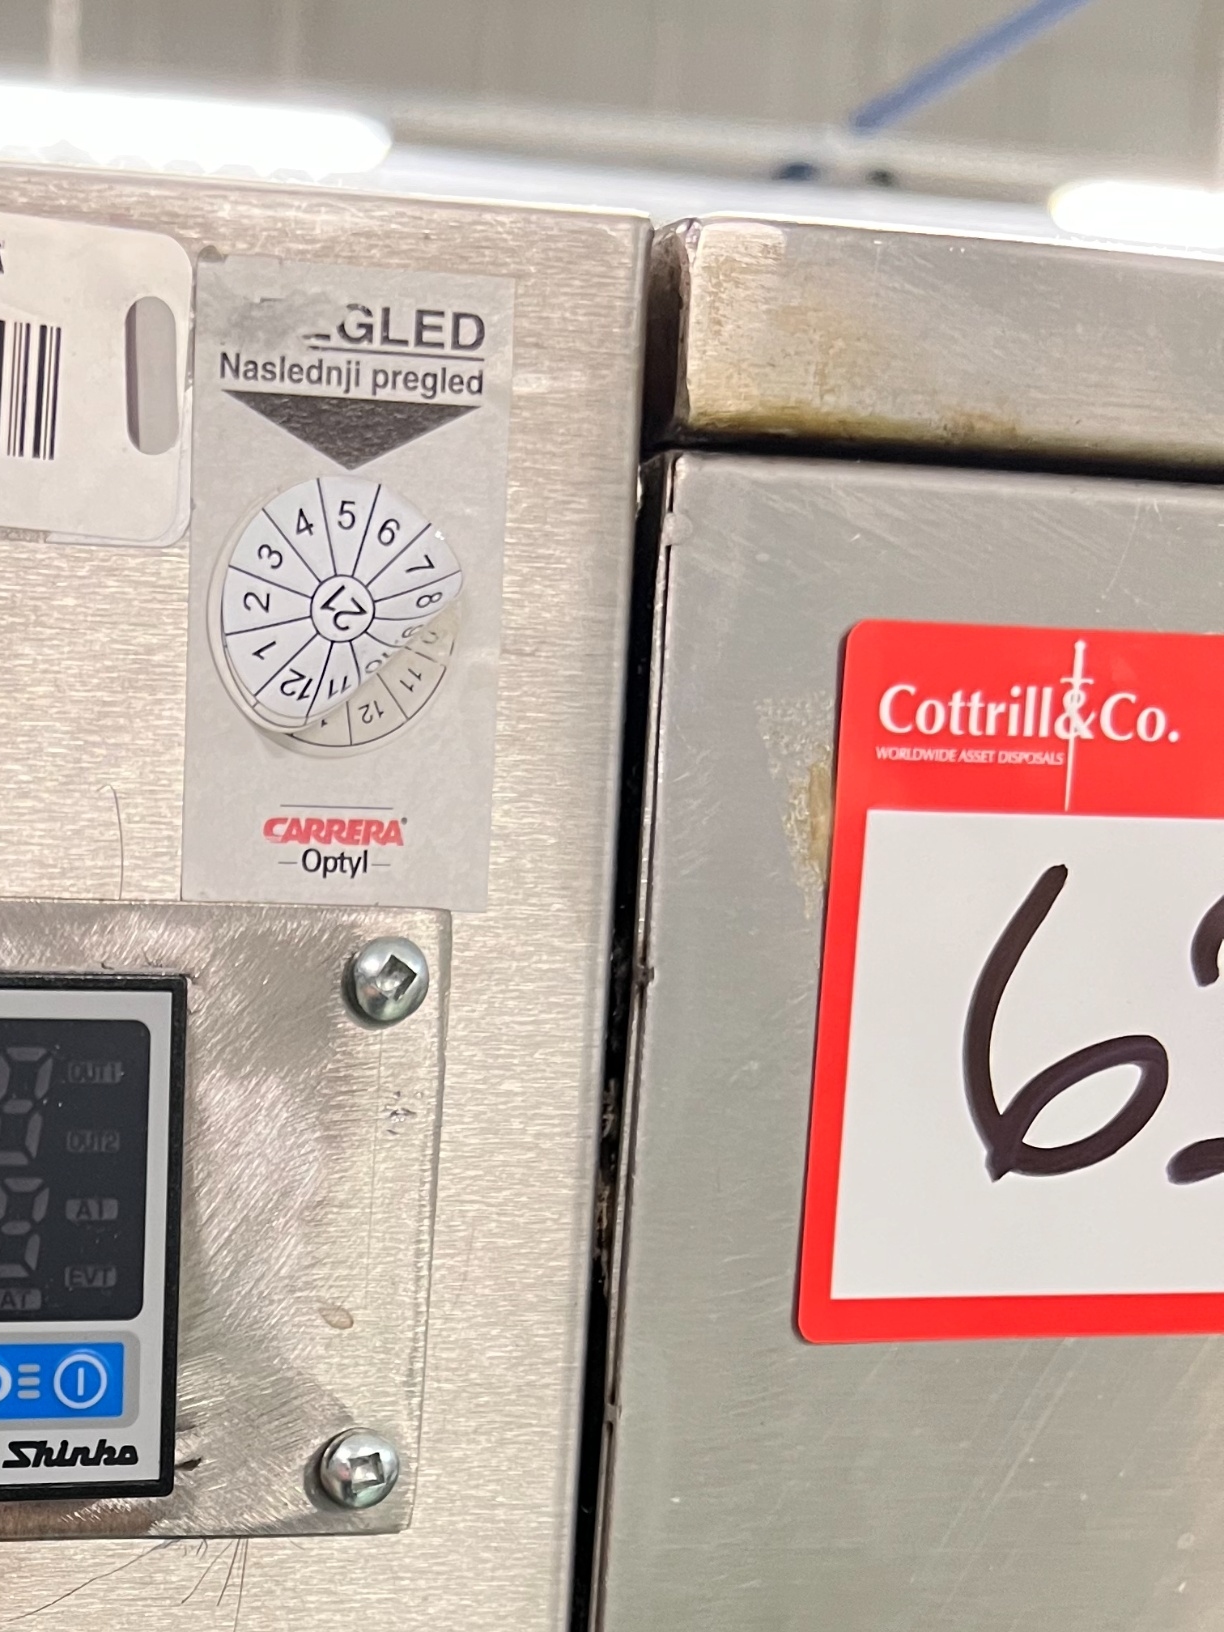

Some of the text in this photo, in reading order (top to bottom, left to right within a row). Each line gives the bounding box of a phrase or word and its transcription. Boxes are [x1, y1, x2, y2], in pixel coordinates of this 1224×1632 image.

[303, 303, 486, 352] GLED
[219, 352, 485, 400] Naslednji pregled
[295, 507, 314, 536] 4
[337, 500, 356, 530] 5
[377, 518, 401, 547] 6
[257, 543, 283, 570] 3
[404, 553, 436, 574] 7
[243, 591, 271, 614] 2
[415, 591, 444, 609] 8
[251, 640, 277, 661] 1
[279, 667, 314, 701] 12
[327, 674, 353, 699] 11
[398, 667, 423, 693] 11
[357, 699, 385, 724] 12
[875, 745, 1066, 767] WORLDWIDE ASSET DISPOSALS
[262, 816, 405, 846] CARRERA
[301, 847, 369, 880] Optyl
[1, 1439, 139, 1470] Shinko
